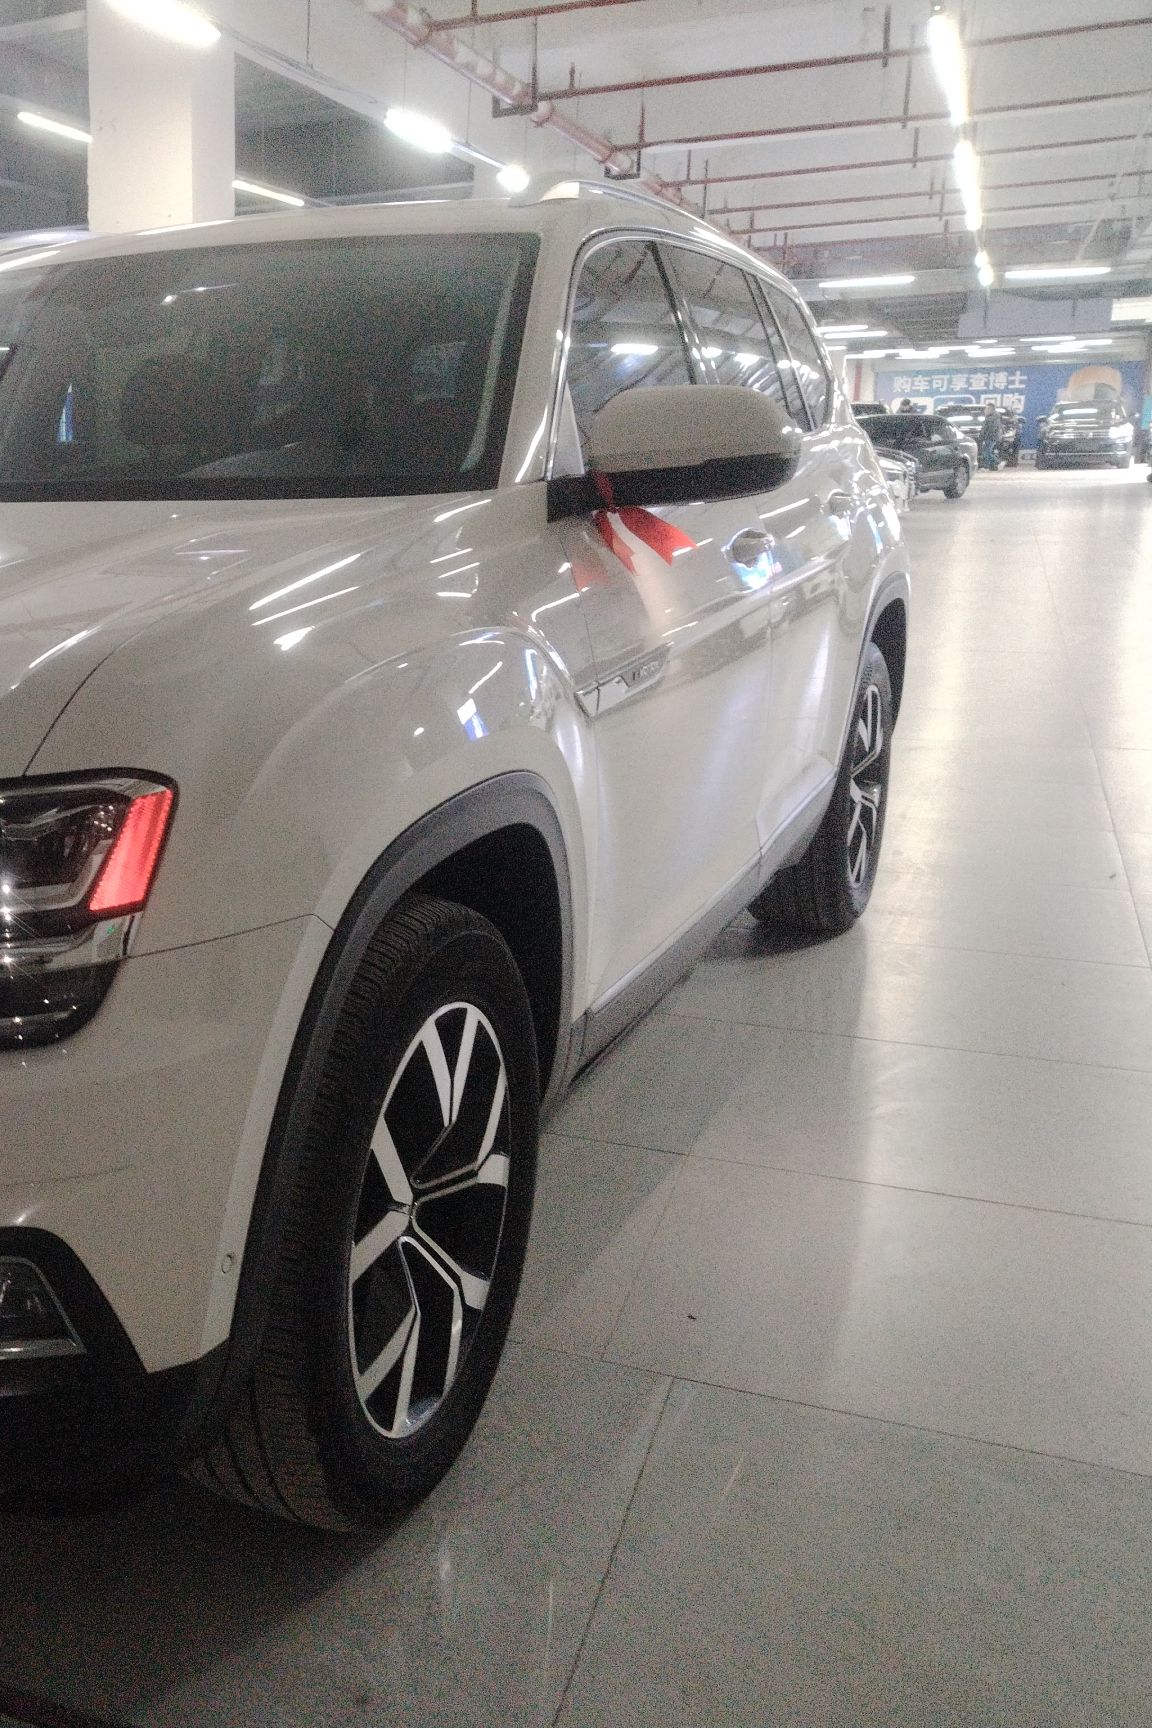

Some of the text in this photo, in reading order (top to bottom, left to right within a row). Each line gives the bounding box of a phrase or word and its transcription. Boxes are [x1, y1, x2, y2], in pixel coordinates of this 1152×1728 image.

[893, 370, 1028, 393] 购车可享查博士
